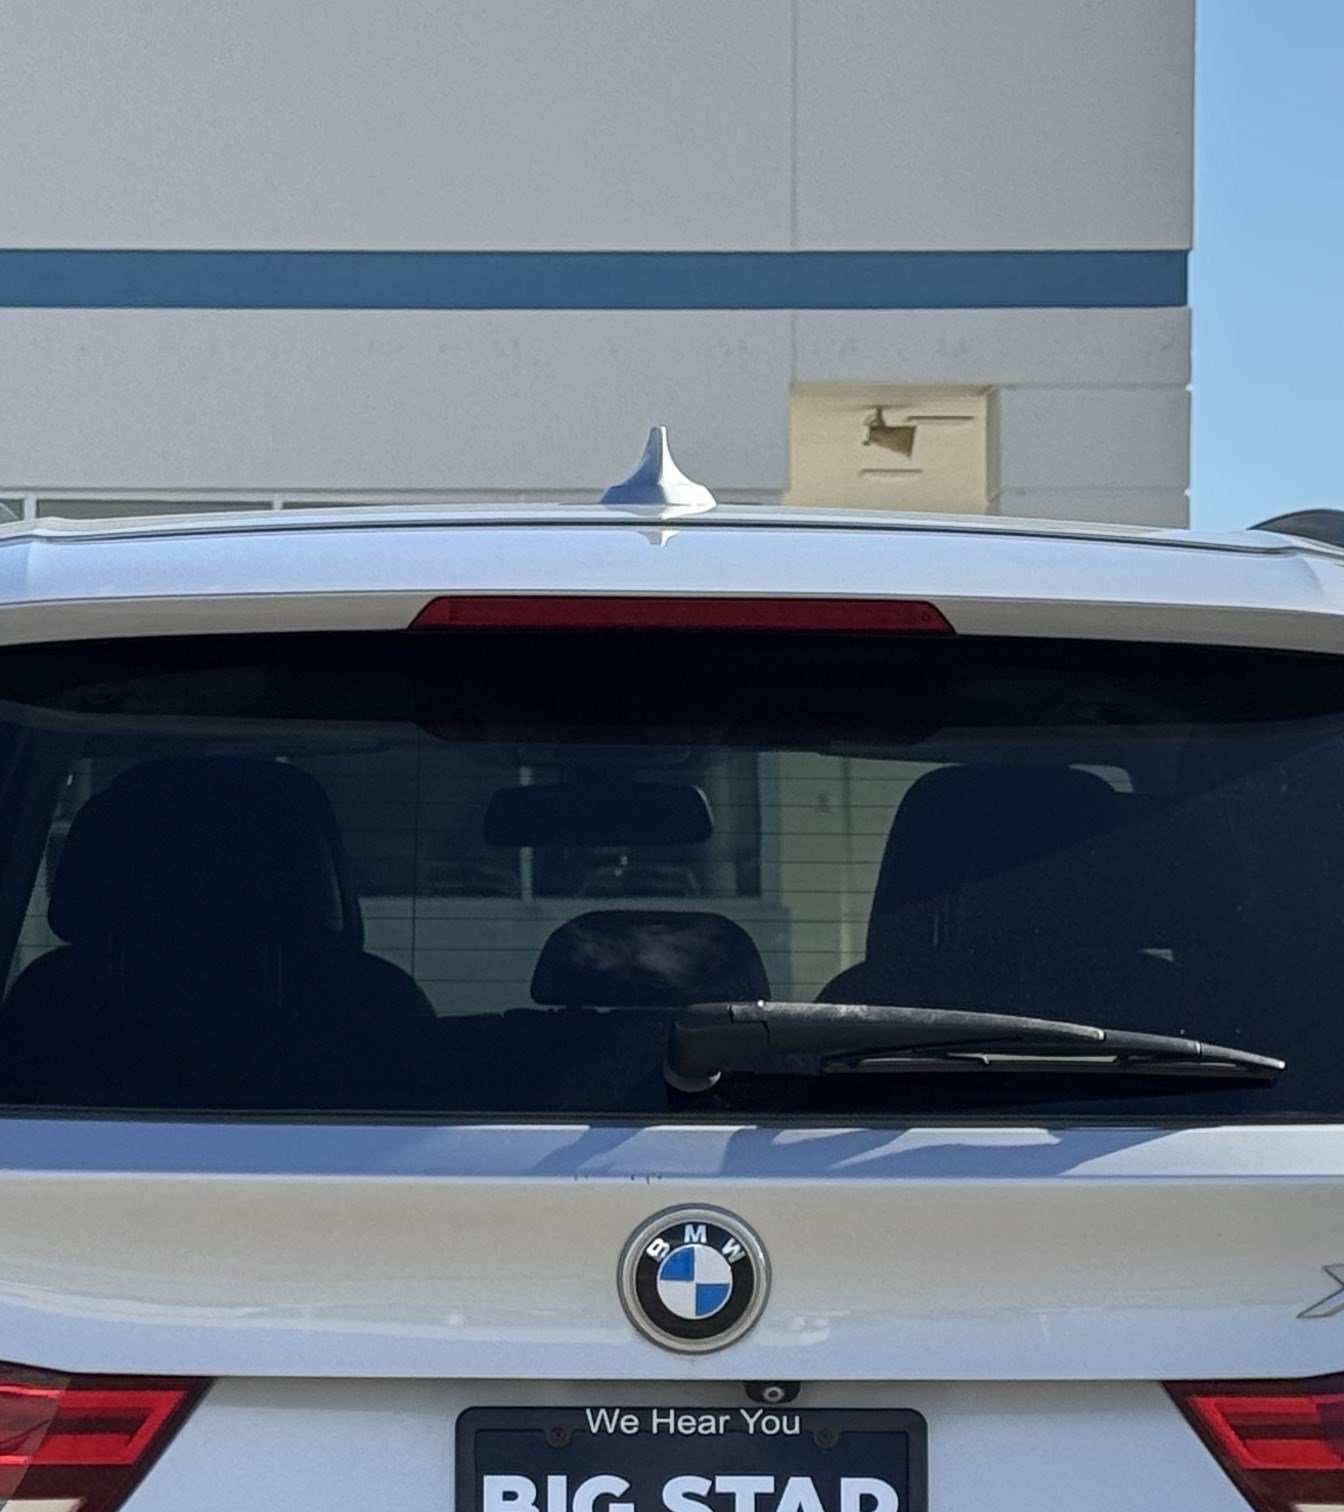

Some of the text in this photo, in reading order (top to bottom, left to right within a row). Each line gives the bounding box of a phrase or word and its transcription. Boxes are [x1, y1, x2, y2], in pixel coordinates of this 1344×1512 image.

[645, 1223, 747, 1263] BMW
[586, 1408, 802, 1436] We Hear You
